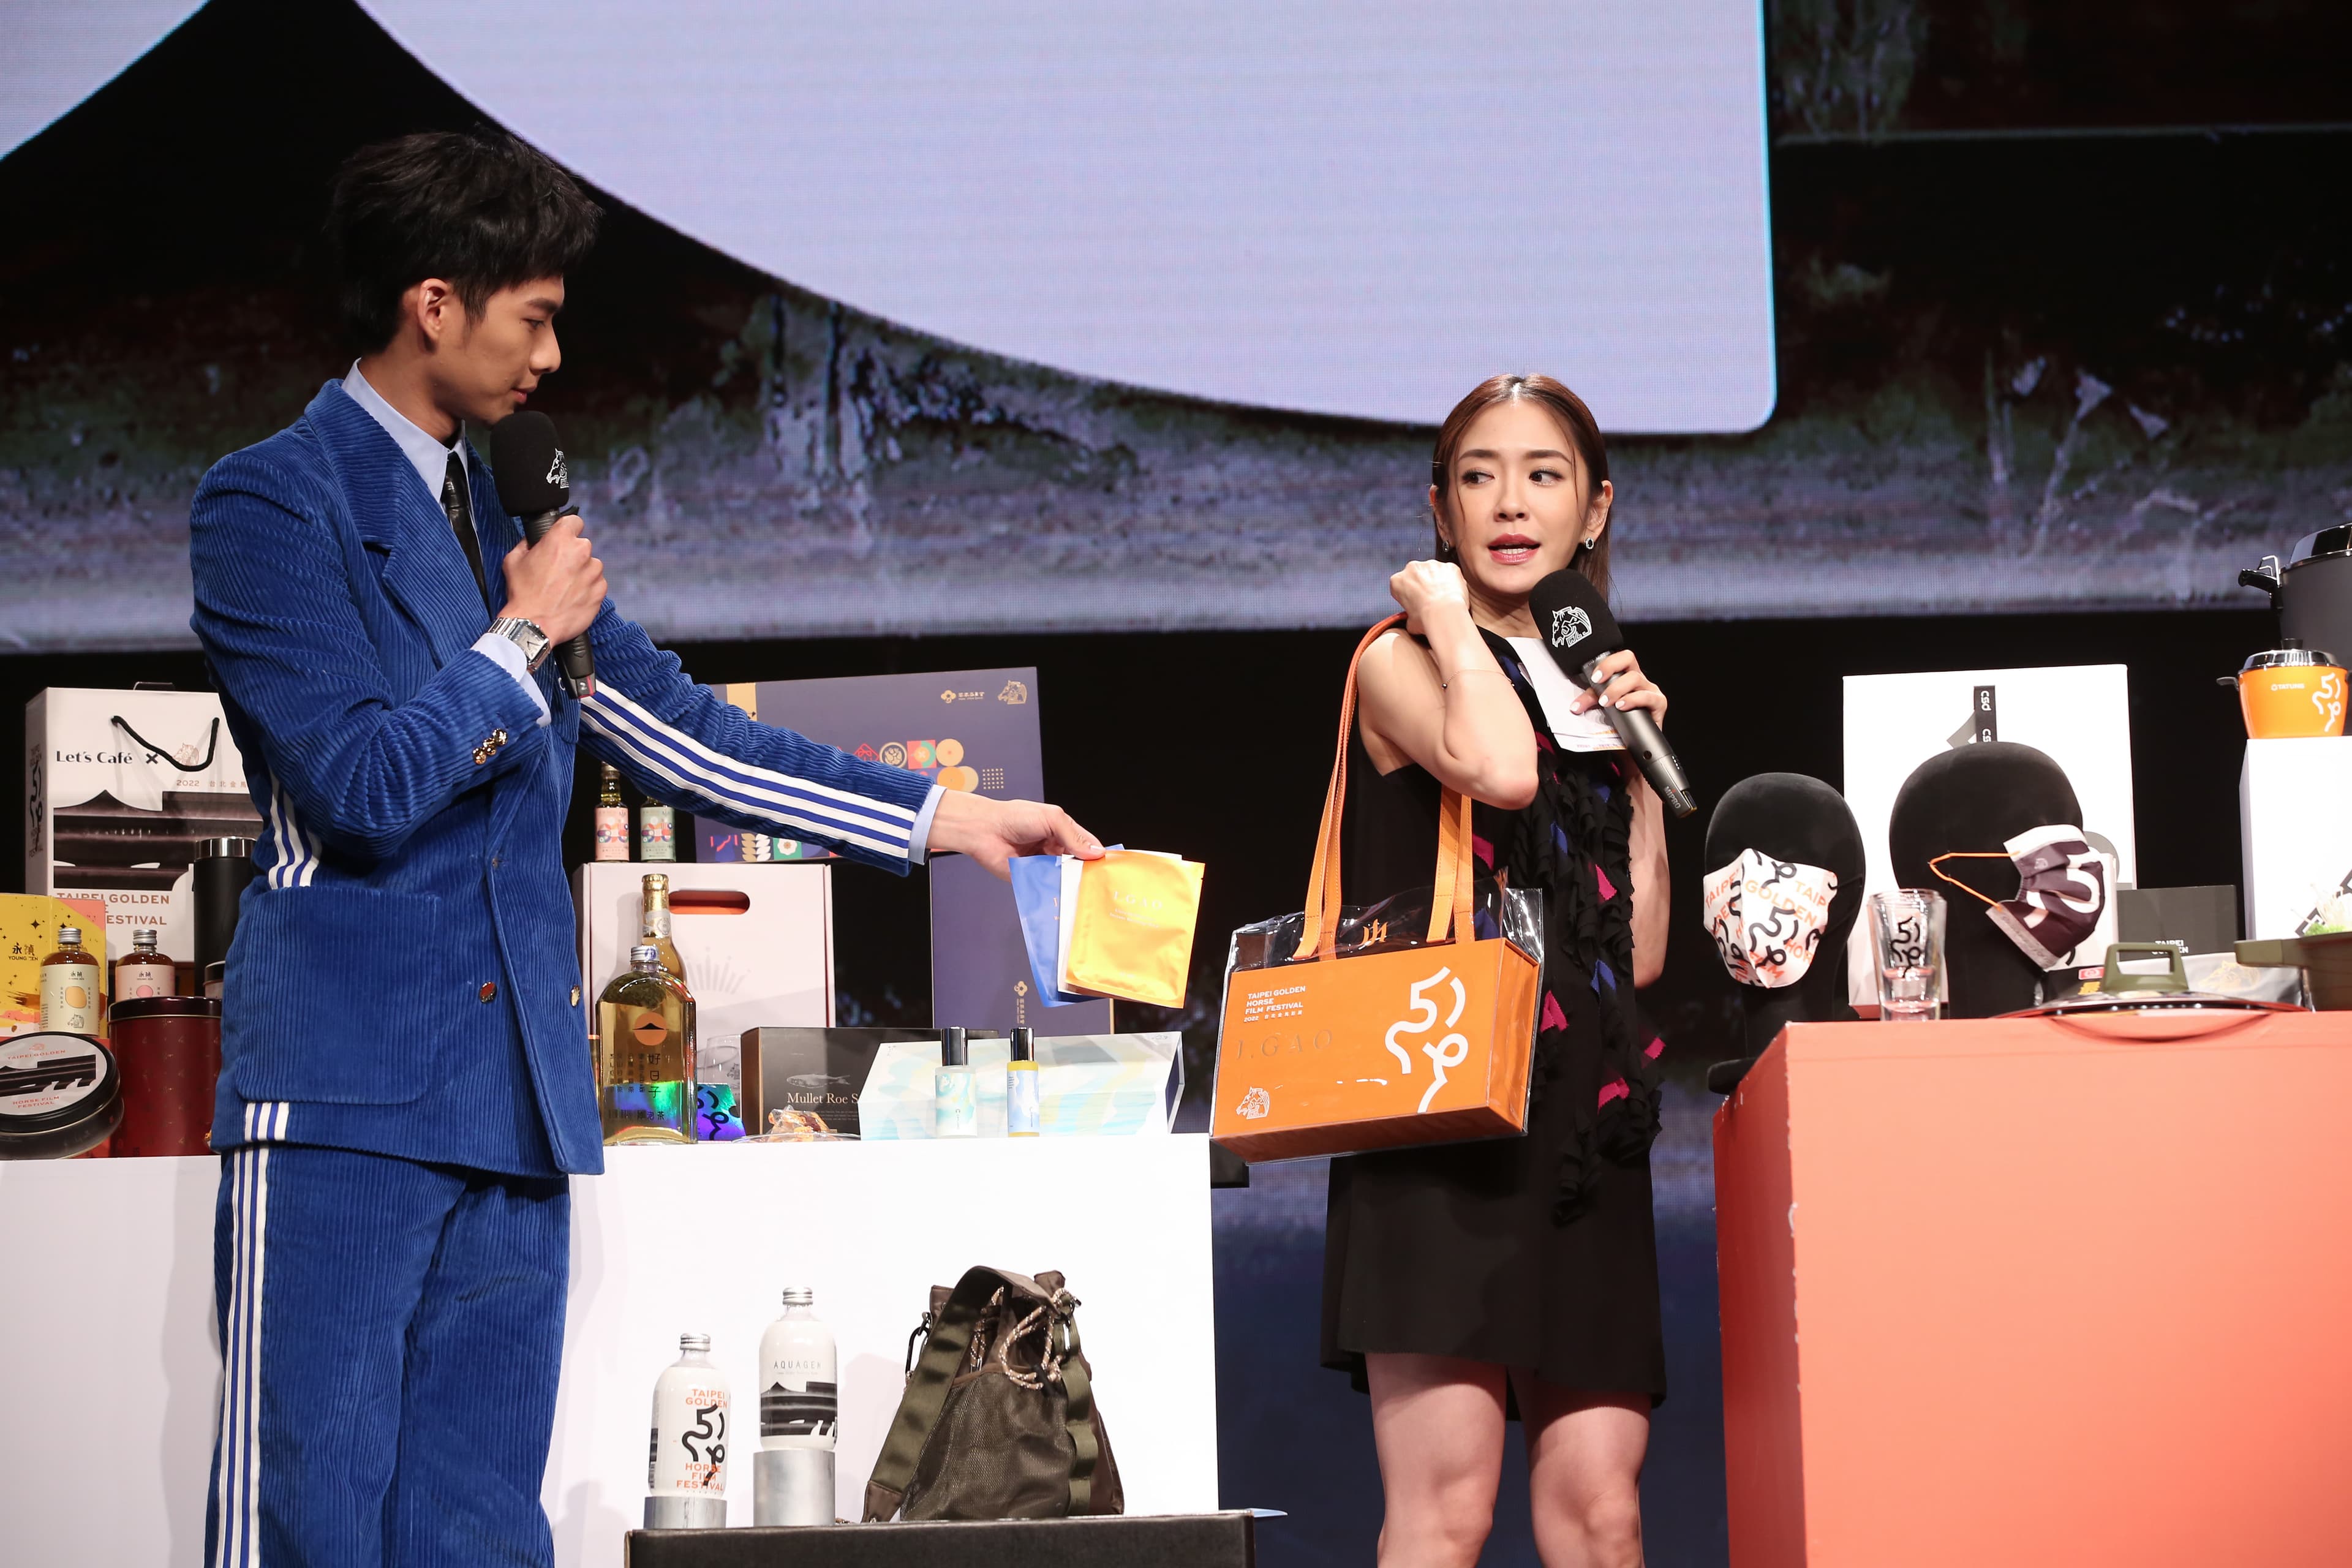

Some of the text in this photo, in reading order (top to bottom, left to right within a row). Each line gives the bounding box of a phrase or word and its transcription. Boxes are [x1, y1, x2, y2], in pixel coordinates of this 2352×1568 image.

[97, 752, 133, 764] Café
[1664, 786, 1681, 809] MIPRO
[109, 894, 170, 904] GOLDEN
[106, 914, 167, 925] ESTIVAL
[1248, 986, 1306, 1000] TAIPEI GOLDEN
[1246, 998, 1274, 1007] HORSE
[1266, 1001, 1303, 1012] FESTIVAL
[648, 1053, 662, 1098] 好日子
[787, 1092, 823, 1104] Mullet
[826, 1093, 848, 1104] Roe
[774, 1359, 822, 1370] AQUAGEN
[692, 1389, 725, 1399] TAIPEI
[685, 1397, 728, 1409] GOLDEN
